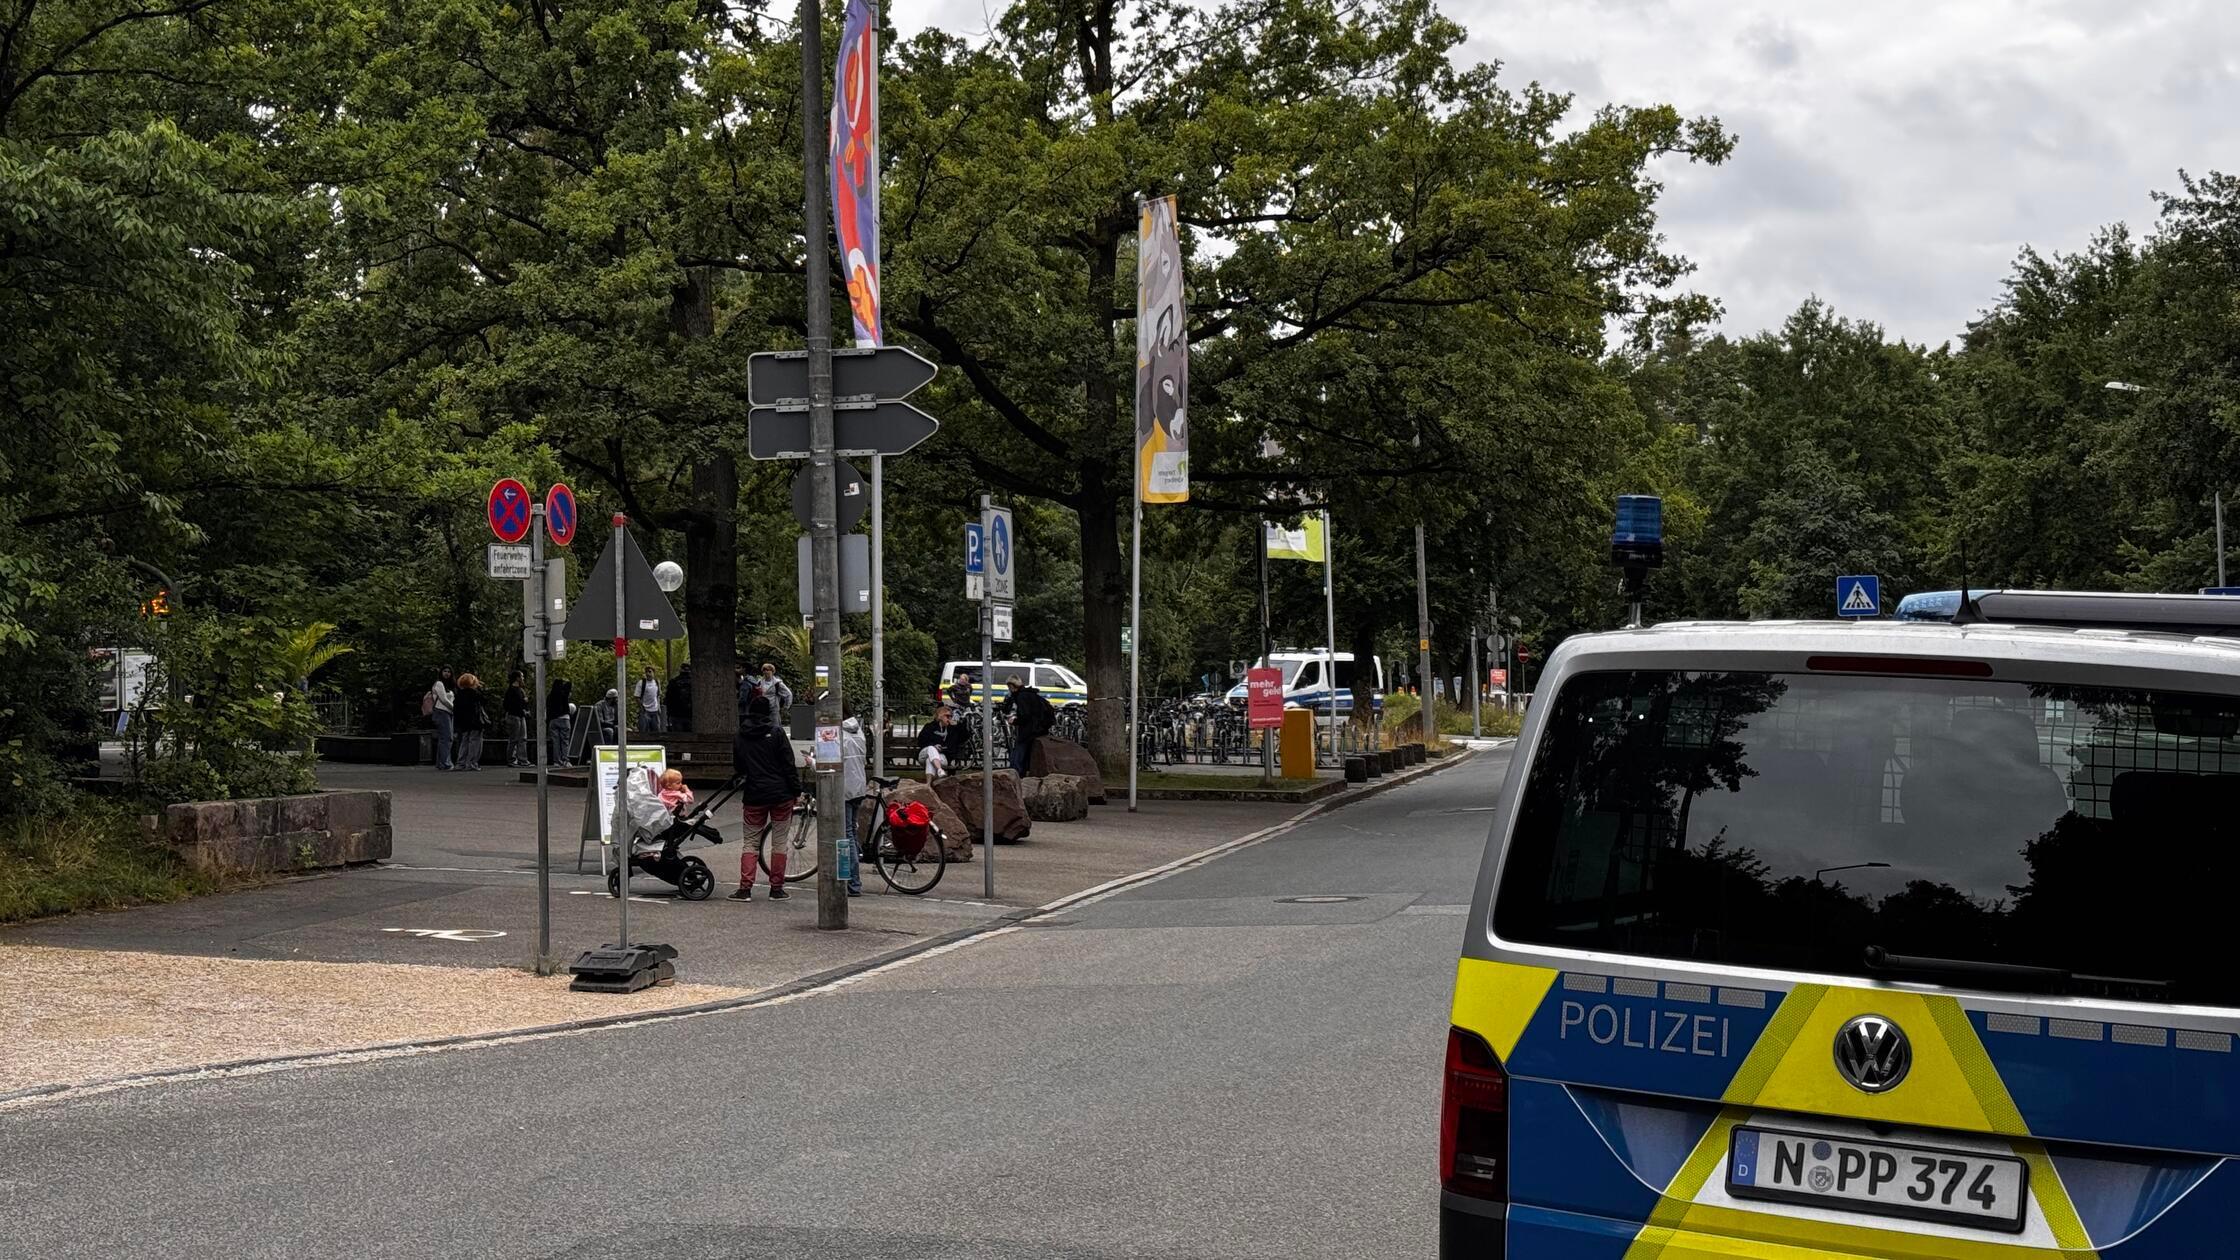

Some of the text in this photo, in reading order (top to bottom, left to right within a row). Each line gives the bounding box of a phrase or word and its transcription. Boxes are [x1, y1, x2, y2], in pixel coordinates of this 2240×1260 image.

[968, 530, 979, 566] P
[1250, 680, 1275, 688] mehr
[1560, 1000, 1729, 1057] POLIZEI
[1738, 1164, 1749, 1177] D
[1773, 1140, 1996, 1210] N PP 374
